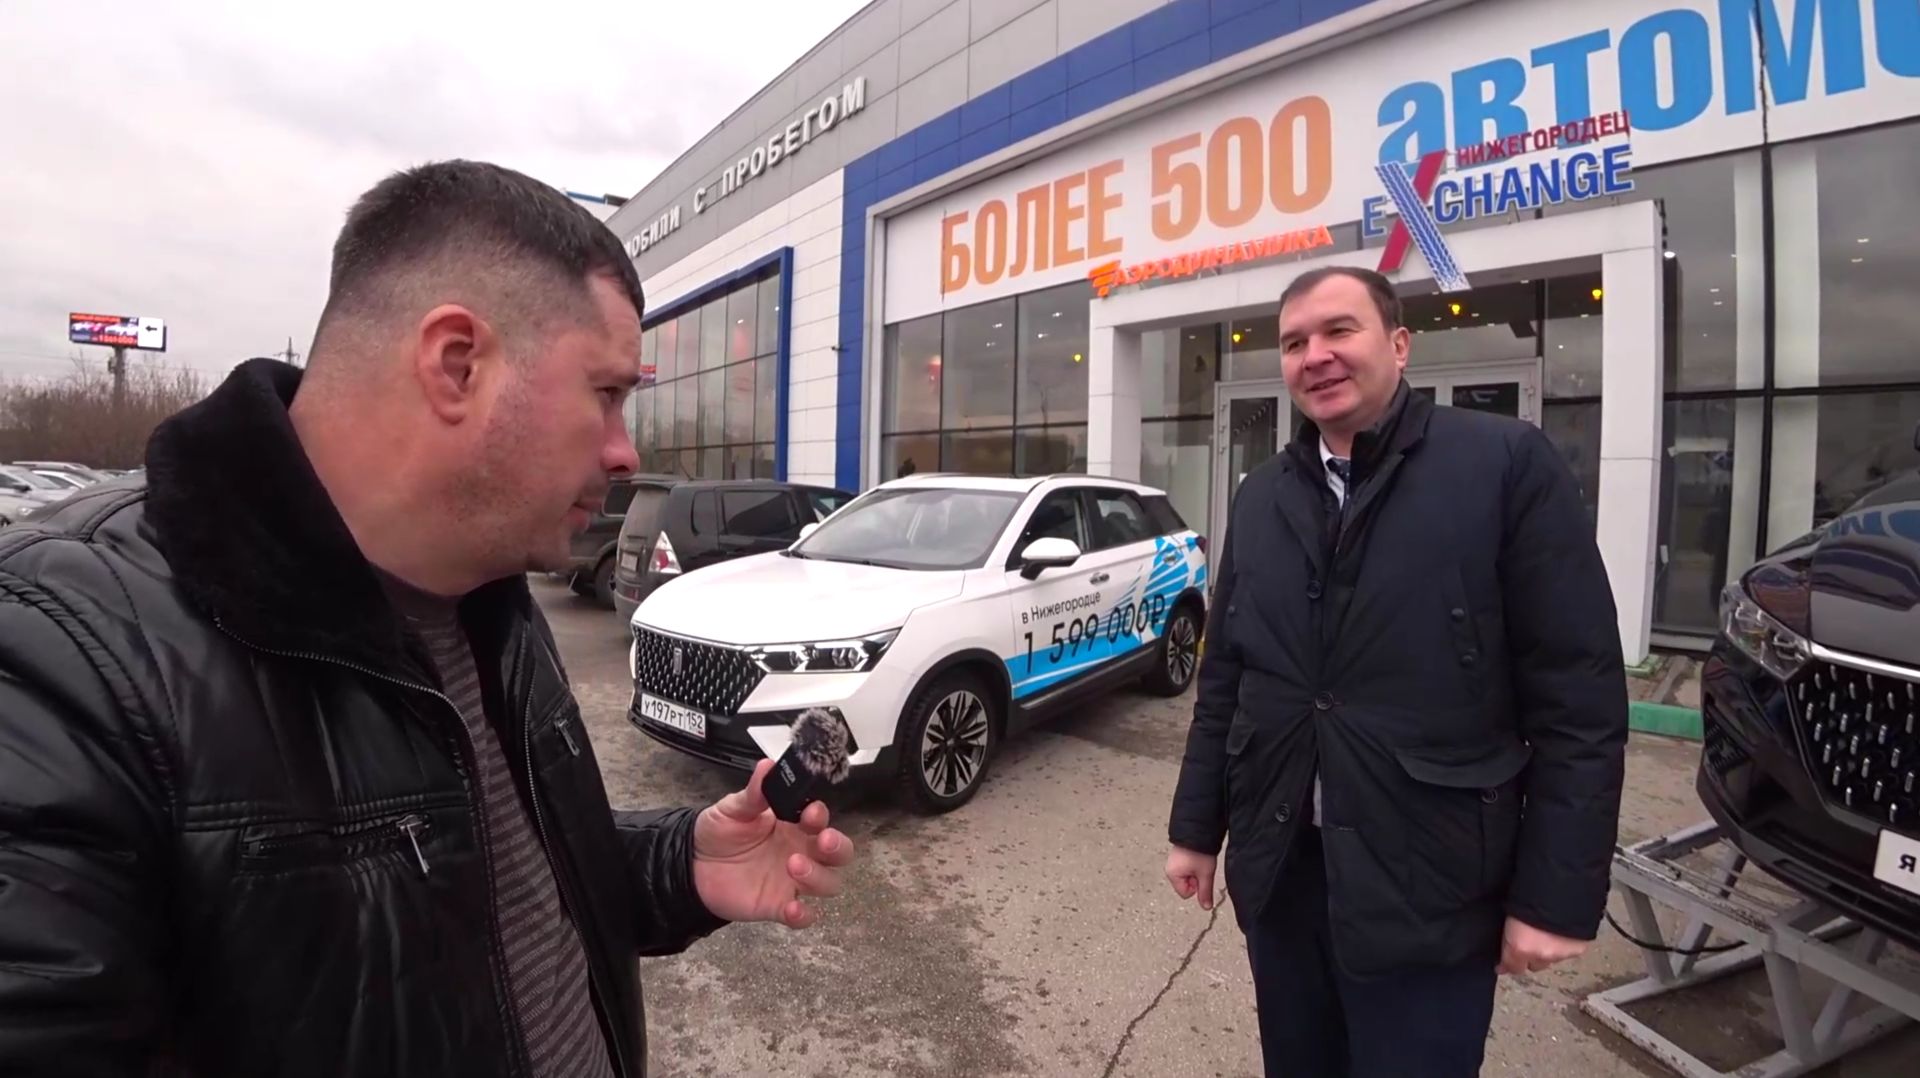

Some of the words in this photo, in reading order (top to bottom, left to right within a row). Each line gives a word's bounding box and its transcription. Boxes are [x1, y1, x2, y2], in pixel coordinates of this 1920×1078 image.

[693, 187, 707, 213] С
[721, 76, 867, 195] ПРОБЕГОМ
[1456, 110, 1631, 166] НИЖЕГОРОДЕЦ
[940, 159, 1124, 295] БОЛЕЕ
[1150, 95, 1333, 242] 500
[1111, 224, 1335, 288] АЭРОДИНАМИКА
[1031, 591, 1102, 622] Нижегородце
[1024, 631, 1033, 674] 1
[1049, 613, 1100, 664] 599
[686, 711, 704, 730] 152
